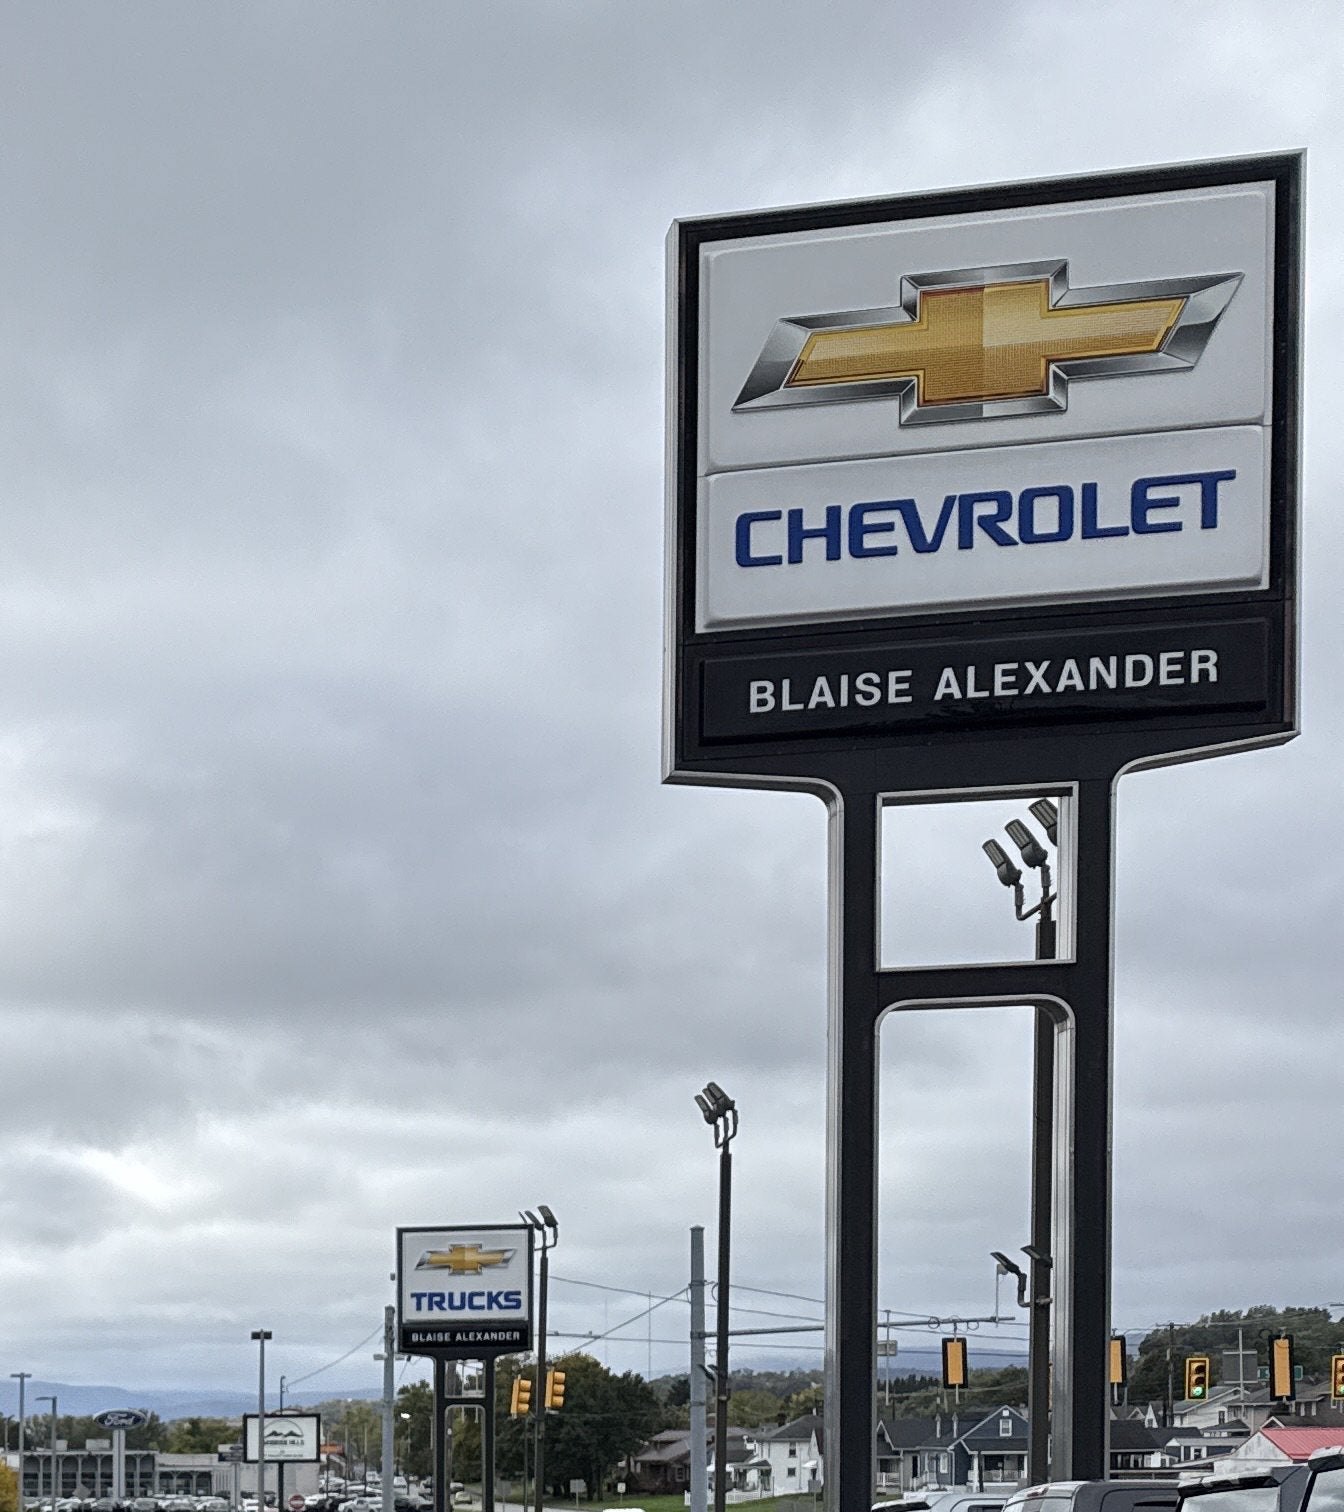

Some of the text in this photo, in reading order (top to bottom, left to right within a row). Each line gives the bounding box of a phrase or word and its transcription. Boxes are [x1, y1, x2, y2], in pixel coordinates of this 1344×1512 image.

[735, 470, 1236, 568] CHEVROLET
[749, 649, 1218, 714] BLAISE ALEXANDER
[411, 1290, 522, 1312] TRUCKS
[411, 1331, 520, 1342] BLAISE ALEXANDER
